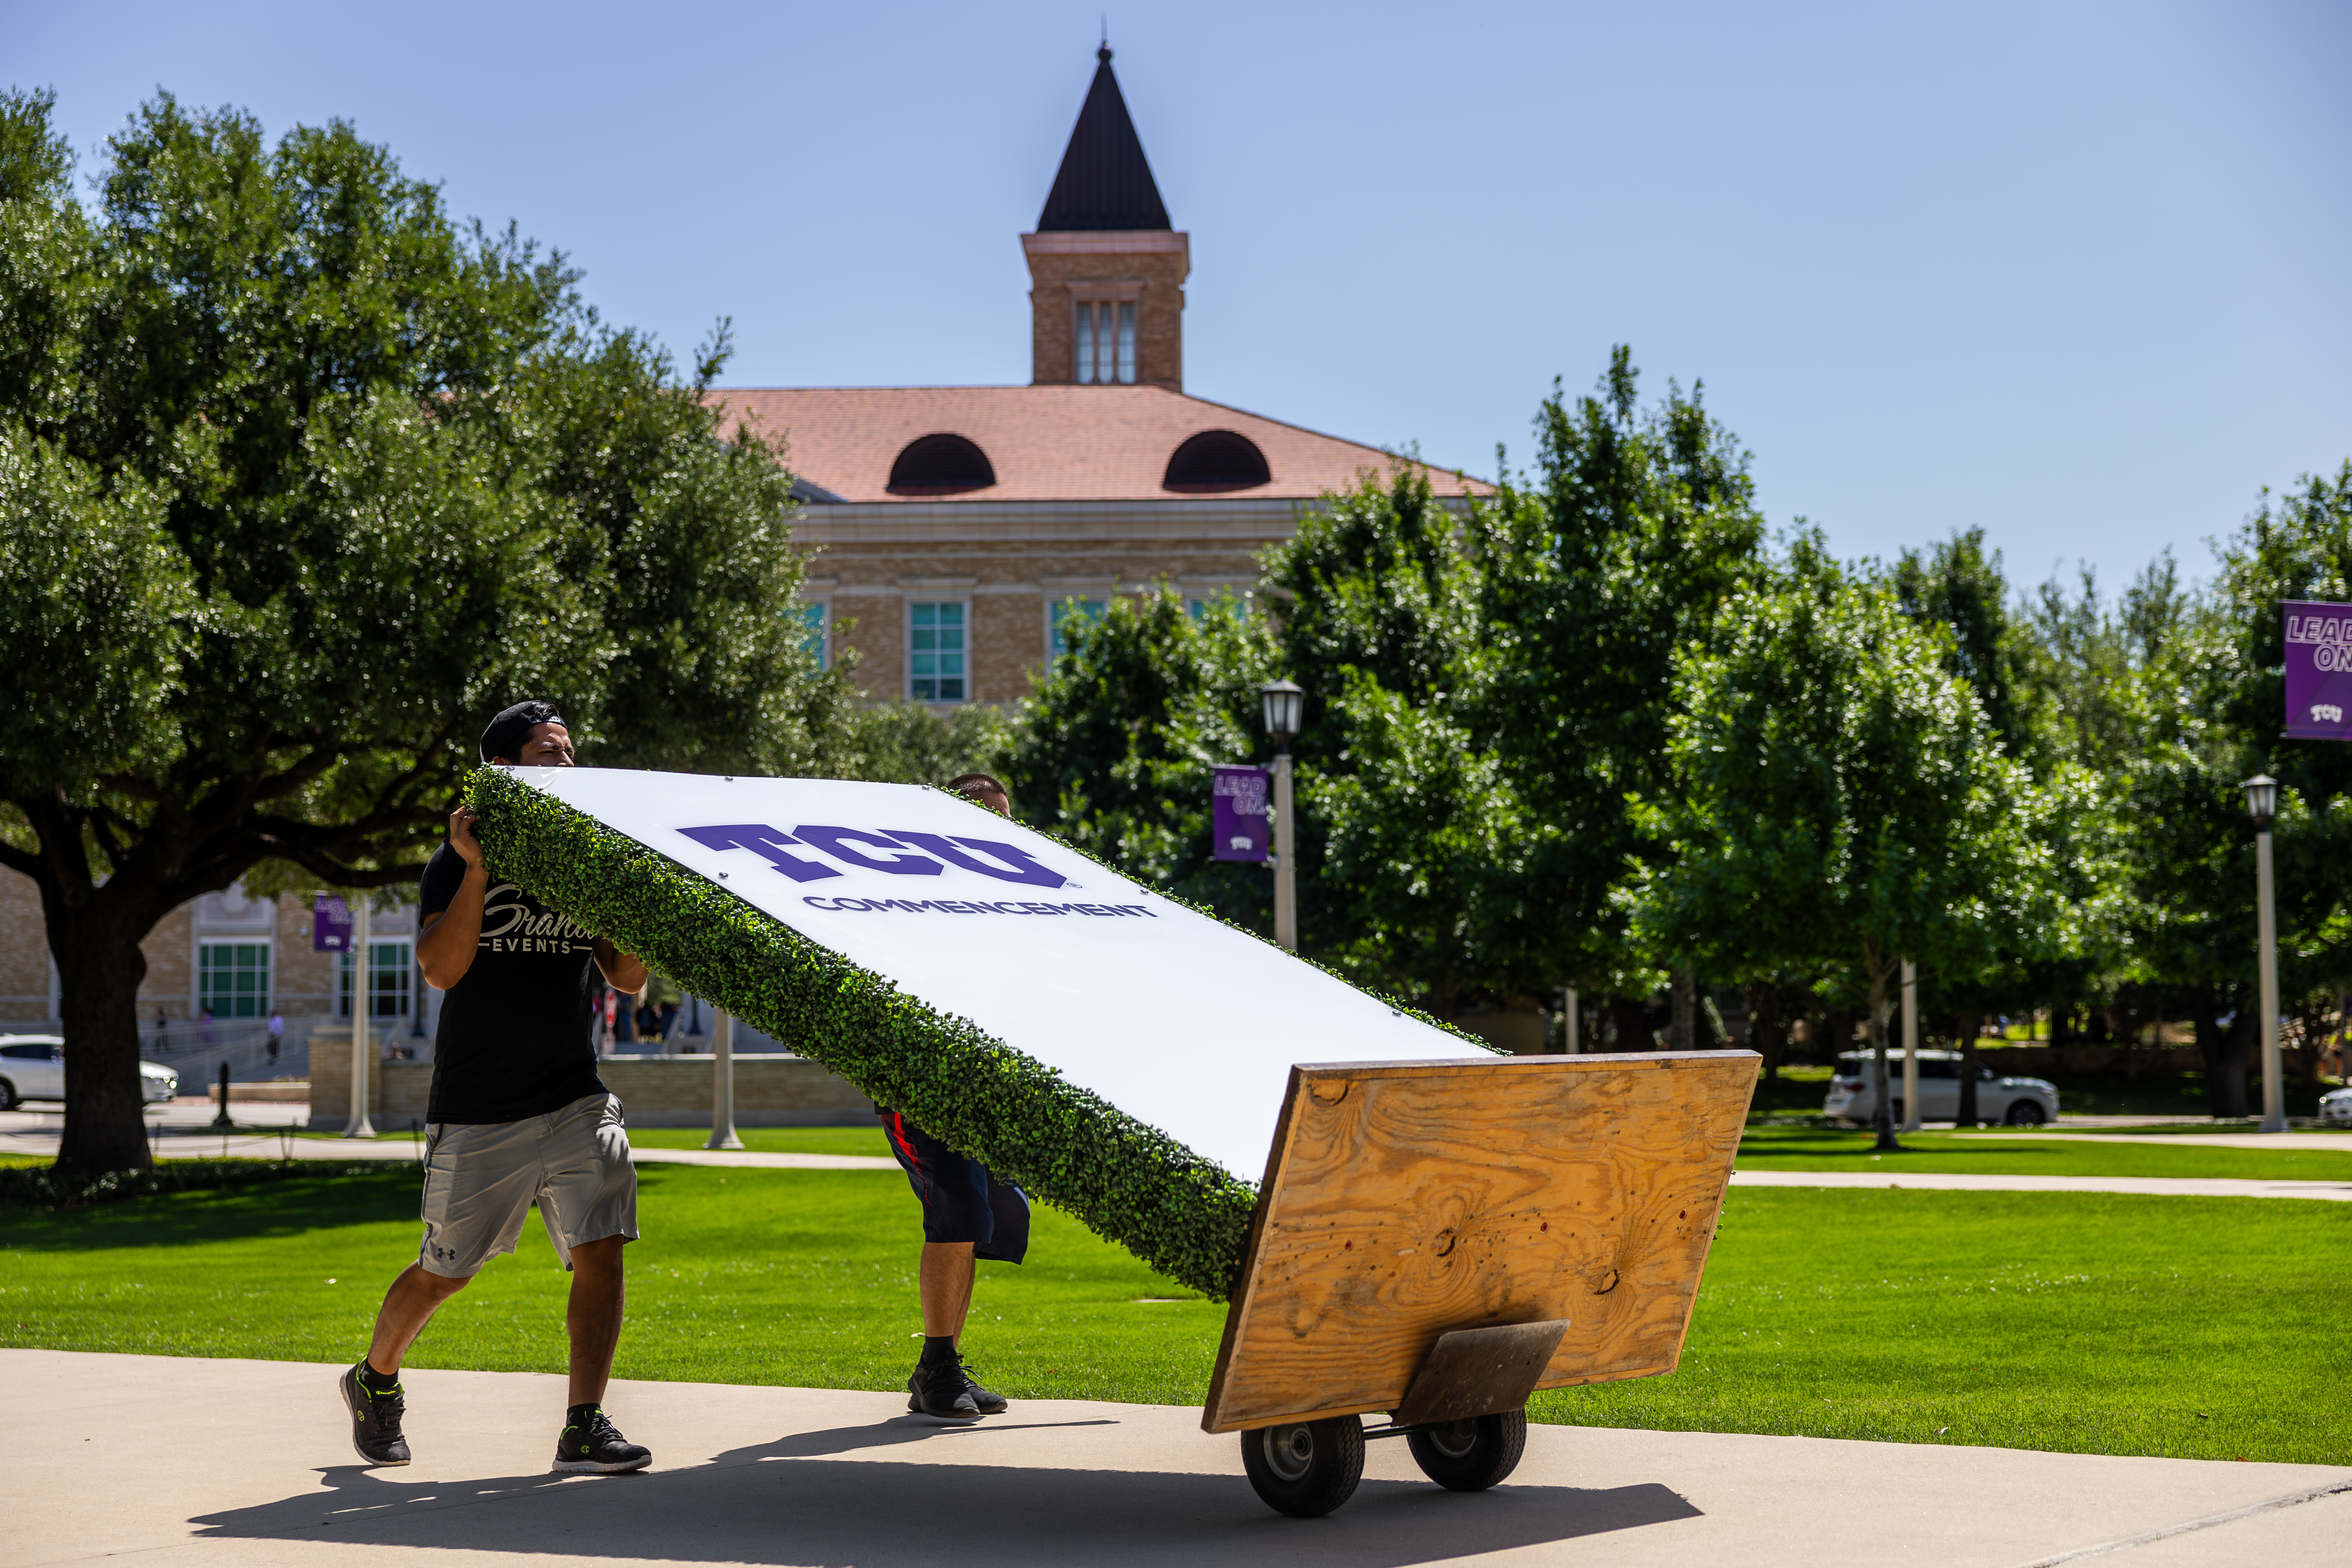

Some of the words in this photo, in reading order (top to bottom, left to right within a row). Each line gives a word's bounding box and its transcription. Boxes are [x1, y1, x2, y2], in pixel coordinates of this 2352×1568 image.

[2310, 704, 2343, 723] TCU
[1214, 775, 1267, 797] LEAD
[675, 824, 1068, 889] TCU
[803, 896, 1158, 917] COMMENCEMENT
[493, 938, 570, 954] EVENTS
